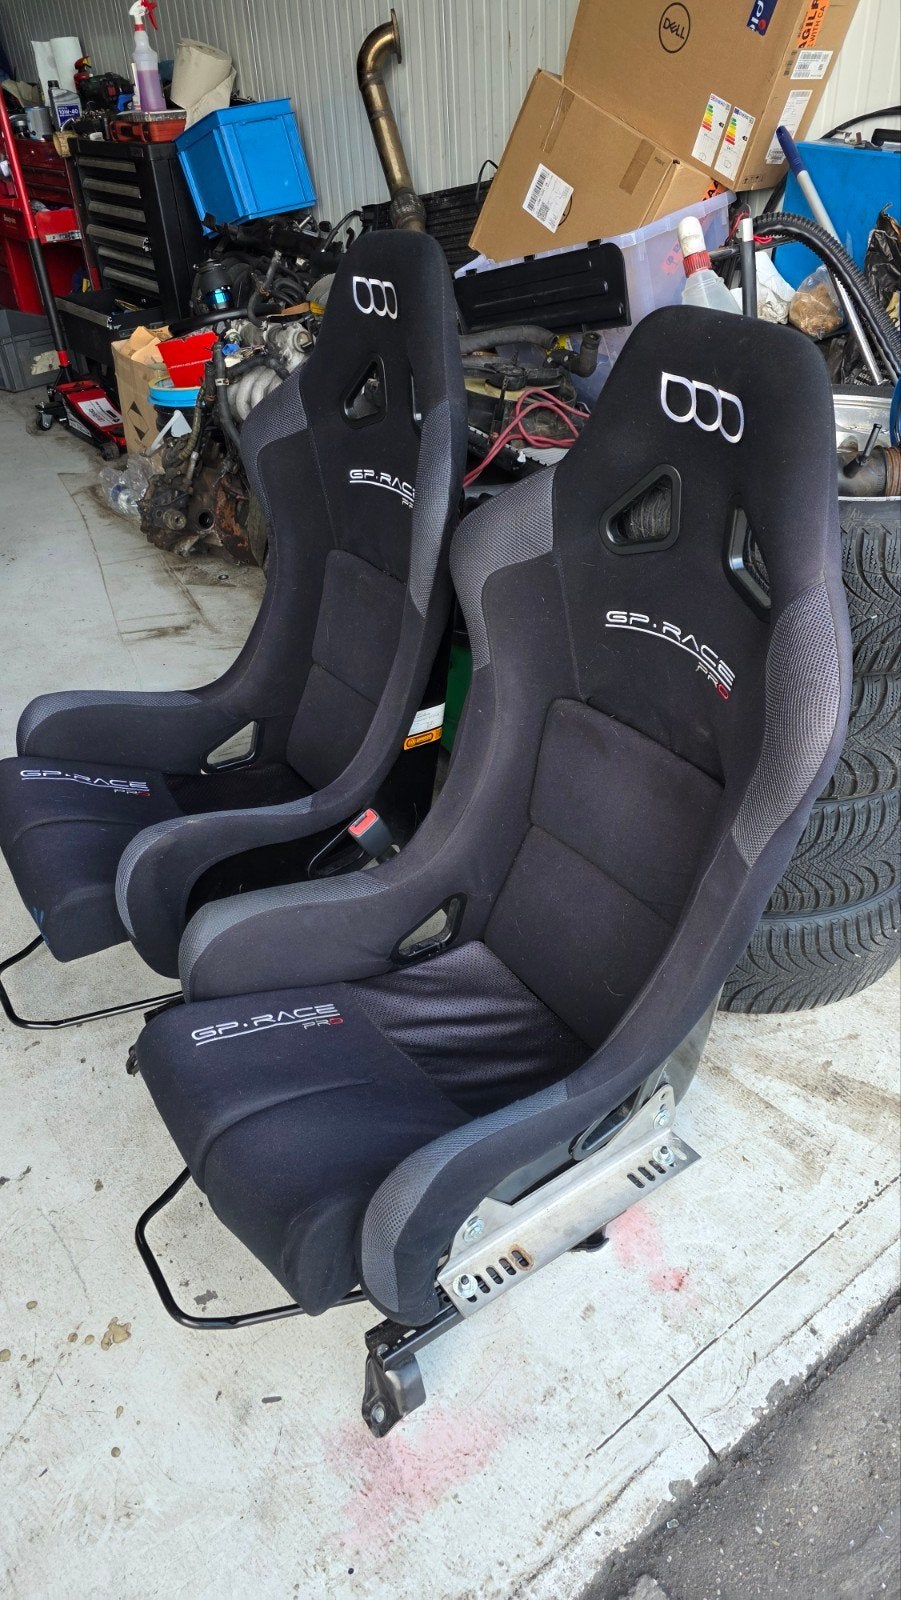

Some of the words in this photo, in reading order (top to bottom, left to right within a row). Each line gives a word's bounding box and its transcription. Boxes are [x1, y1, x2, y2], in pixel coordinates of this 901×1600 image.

[663, 17, 685, 40] DELL
[695, 661, 729, 700] PRO
[302, 1016, 344, 1030] PRO
